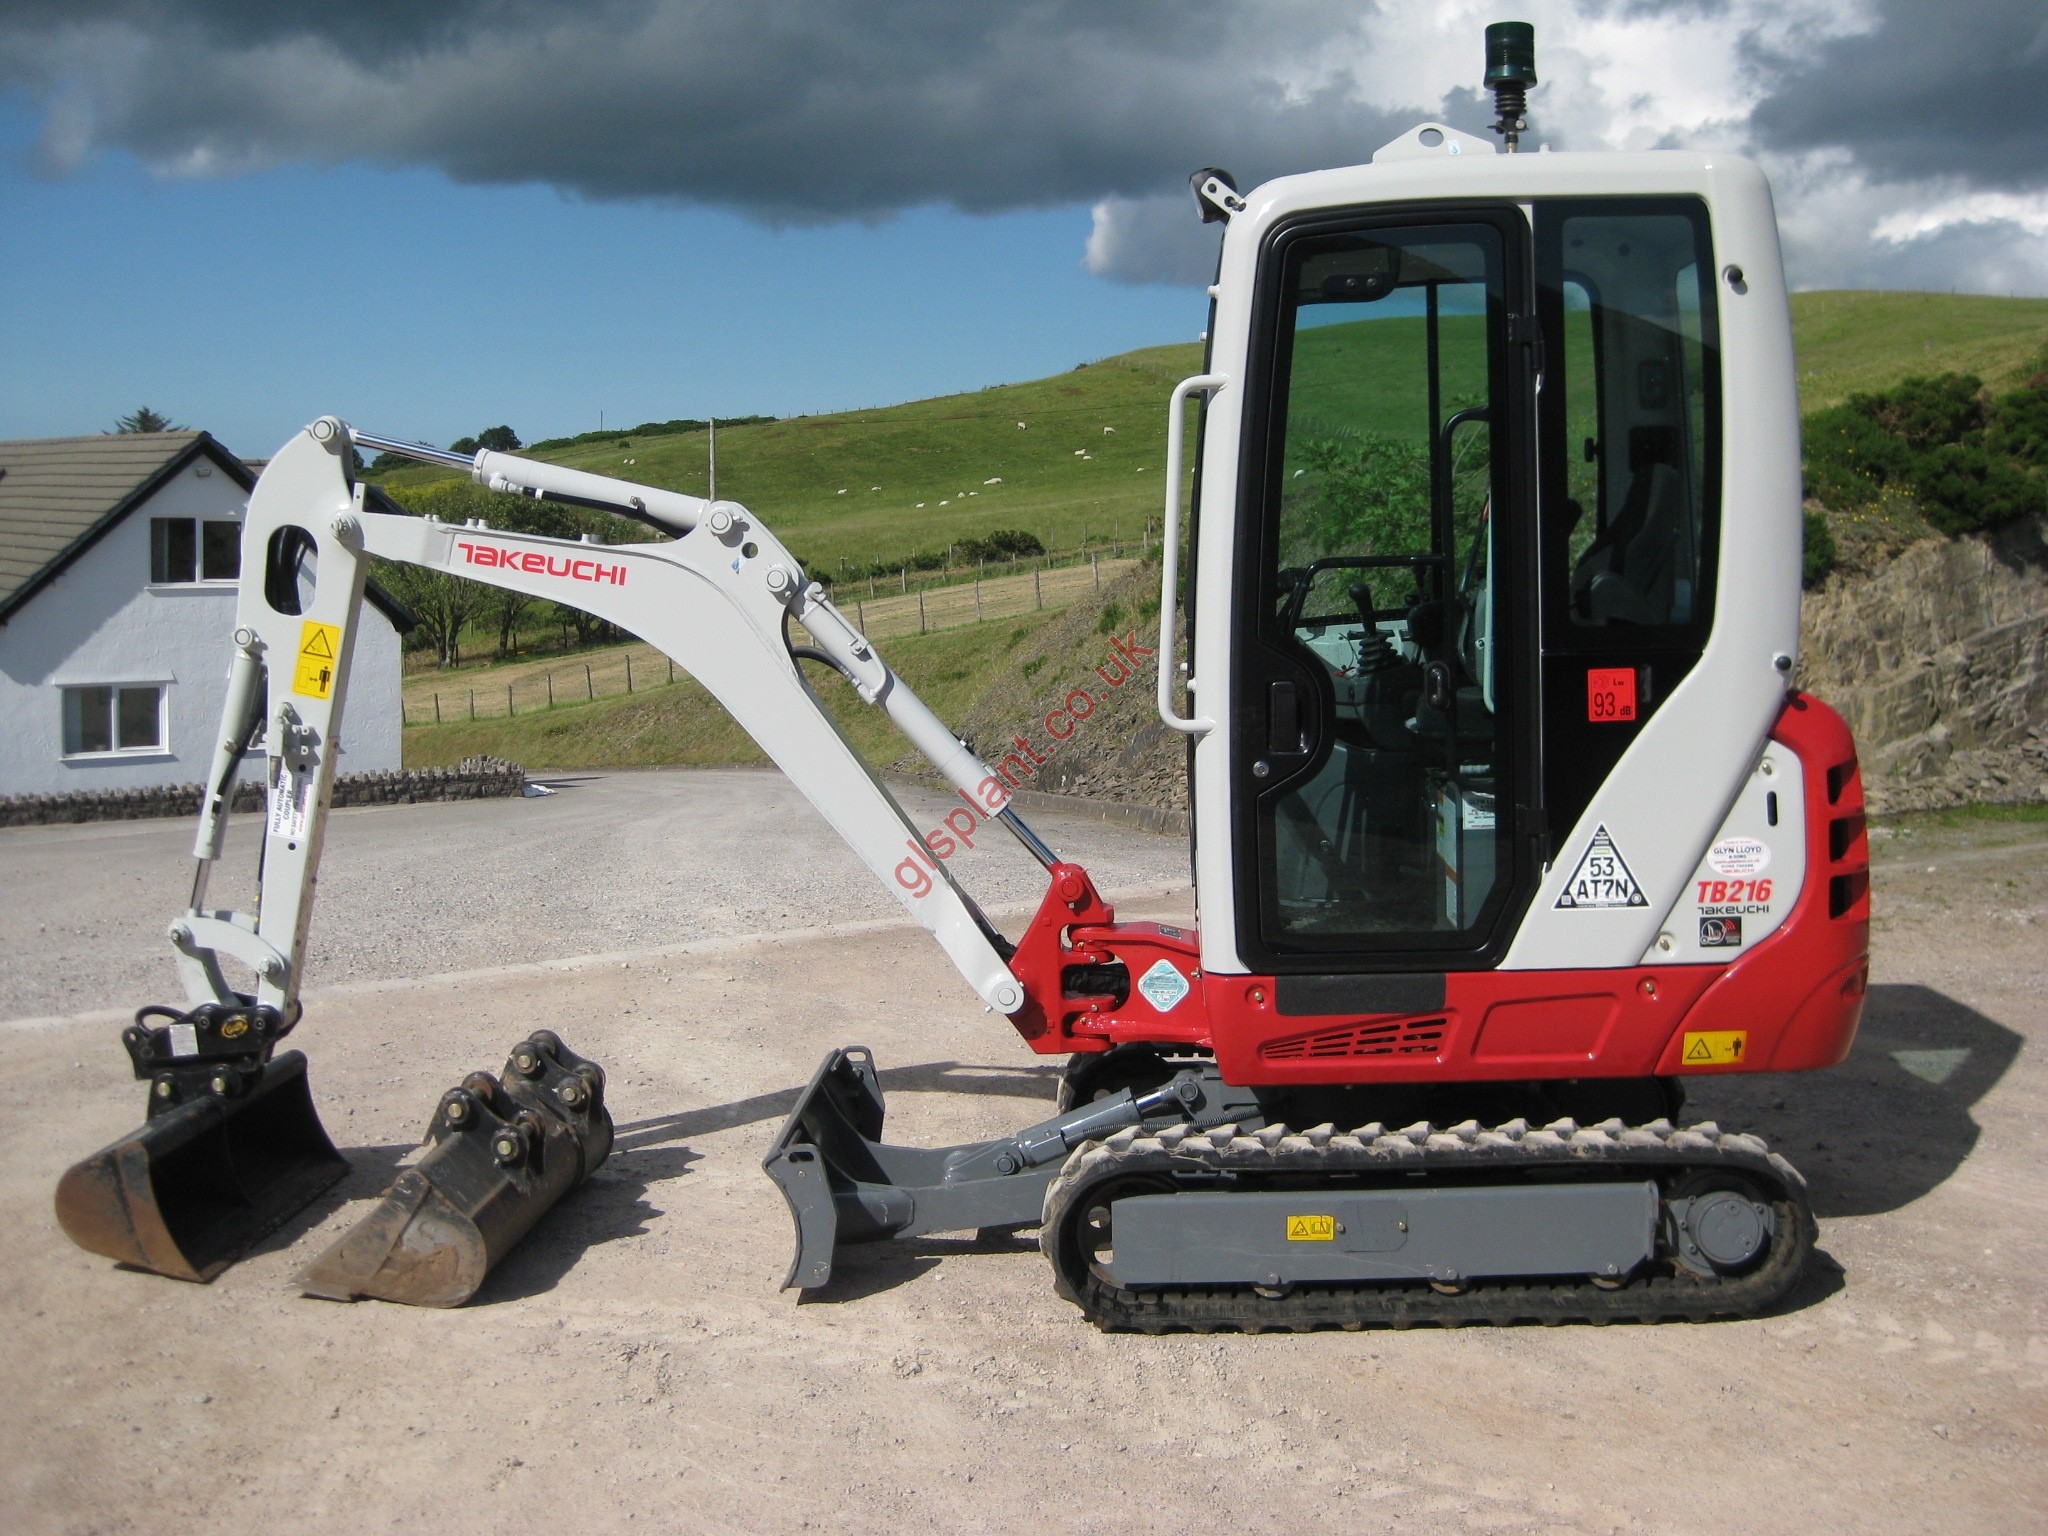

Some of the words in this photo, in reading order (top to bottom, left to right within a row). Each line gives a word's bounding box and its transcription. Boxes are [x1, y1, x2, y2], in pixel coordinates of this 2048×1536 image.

[458, 543, 627, 586] TAKEUCHI
[1594, 692, 1616, 717] 93
[1620, 705, 1632, 716] dB
[273, 813, 281, 833] FULLY
[277, 773, 288, 812] AUTOMATIC
[283, 790, 293, 820] COUPLER
[1713, 847, 1735, 855] GLYN
[1736, 846, 1762, 854] LLOYD
[1590, 857, 1614, 877] 53
[1577, 879, 1628, 899] AT7N
[1697, 879, 1773, 903] TB216
[1697, 905, 1770, 915] TAKEUCHI
